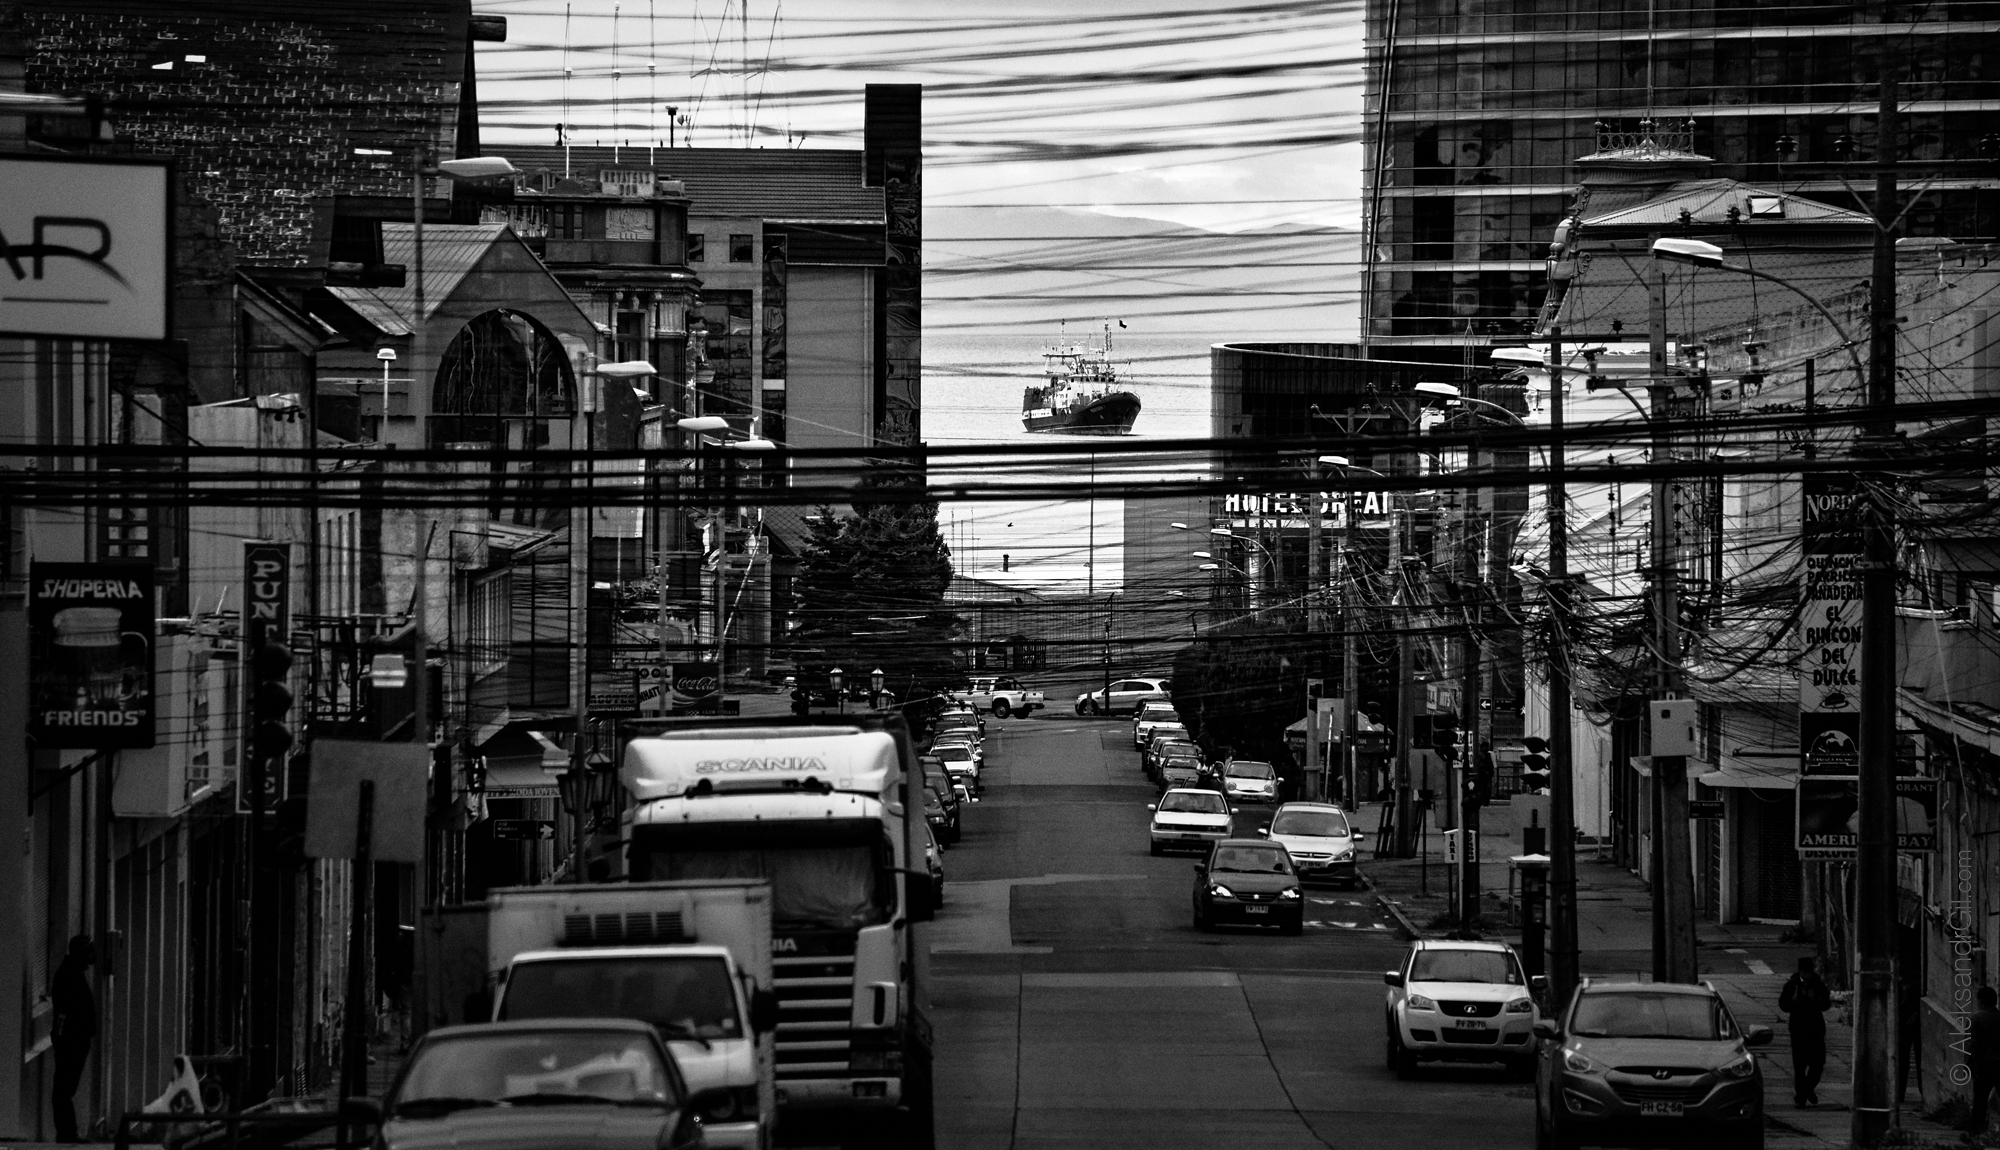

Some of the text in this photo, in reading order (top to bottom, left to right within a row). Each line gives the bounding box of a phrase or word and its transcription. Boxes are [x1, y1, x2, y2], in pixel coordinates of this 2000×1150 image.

[37, 578, 144, 599] SHOPERIA
[1826, 606, 1841, 622] EL
[1822, 648, 1847, 665] DEL
[1813, 669, 1856, 686] DULCE
[695, 757, 826, 774] SCANIA
[1801, 833, 1933, 848] AMERI BAY
